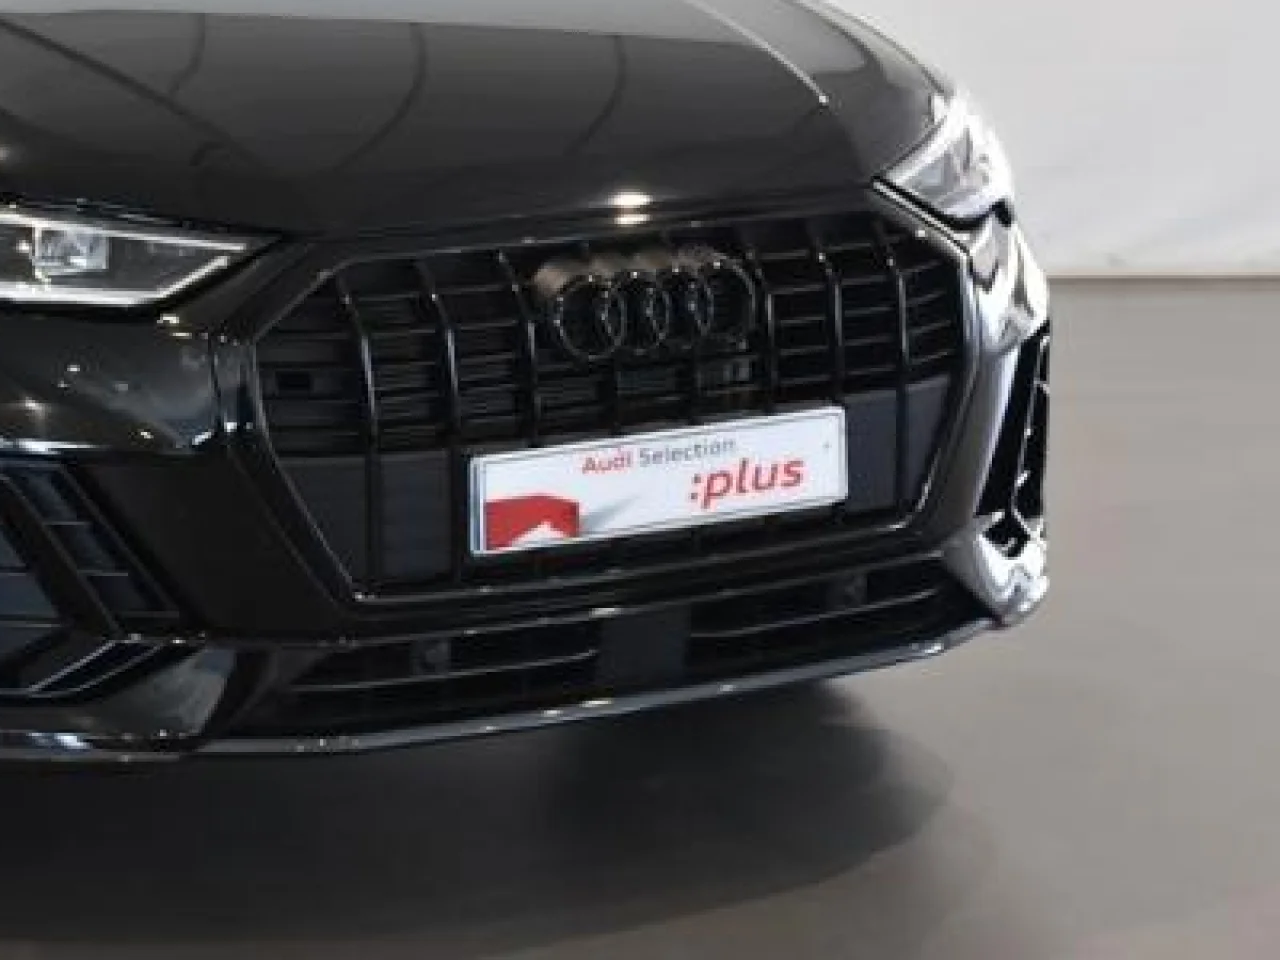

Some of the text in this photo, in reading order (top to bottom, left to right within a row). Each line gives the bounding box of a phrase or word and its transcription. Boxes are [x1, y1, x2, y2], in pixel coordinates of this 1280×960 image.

[582, 437, 736, 474] Audi Selection
[690, 456, 804, 510] :plus
